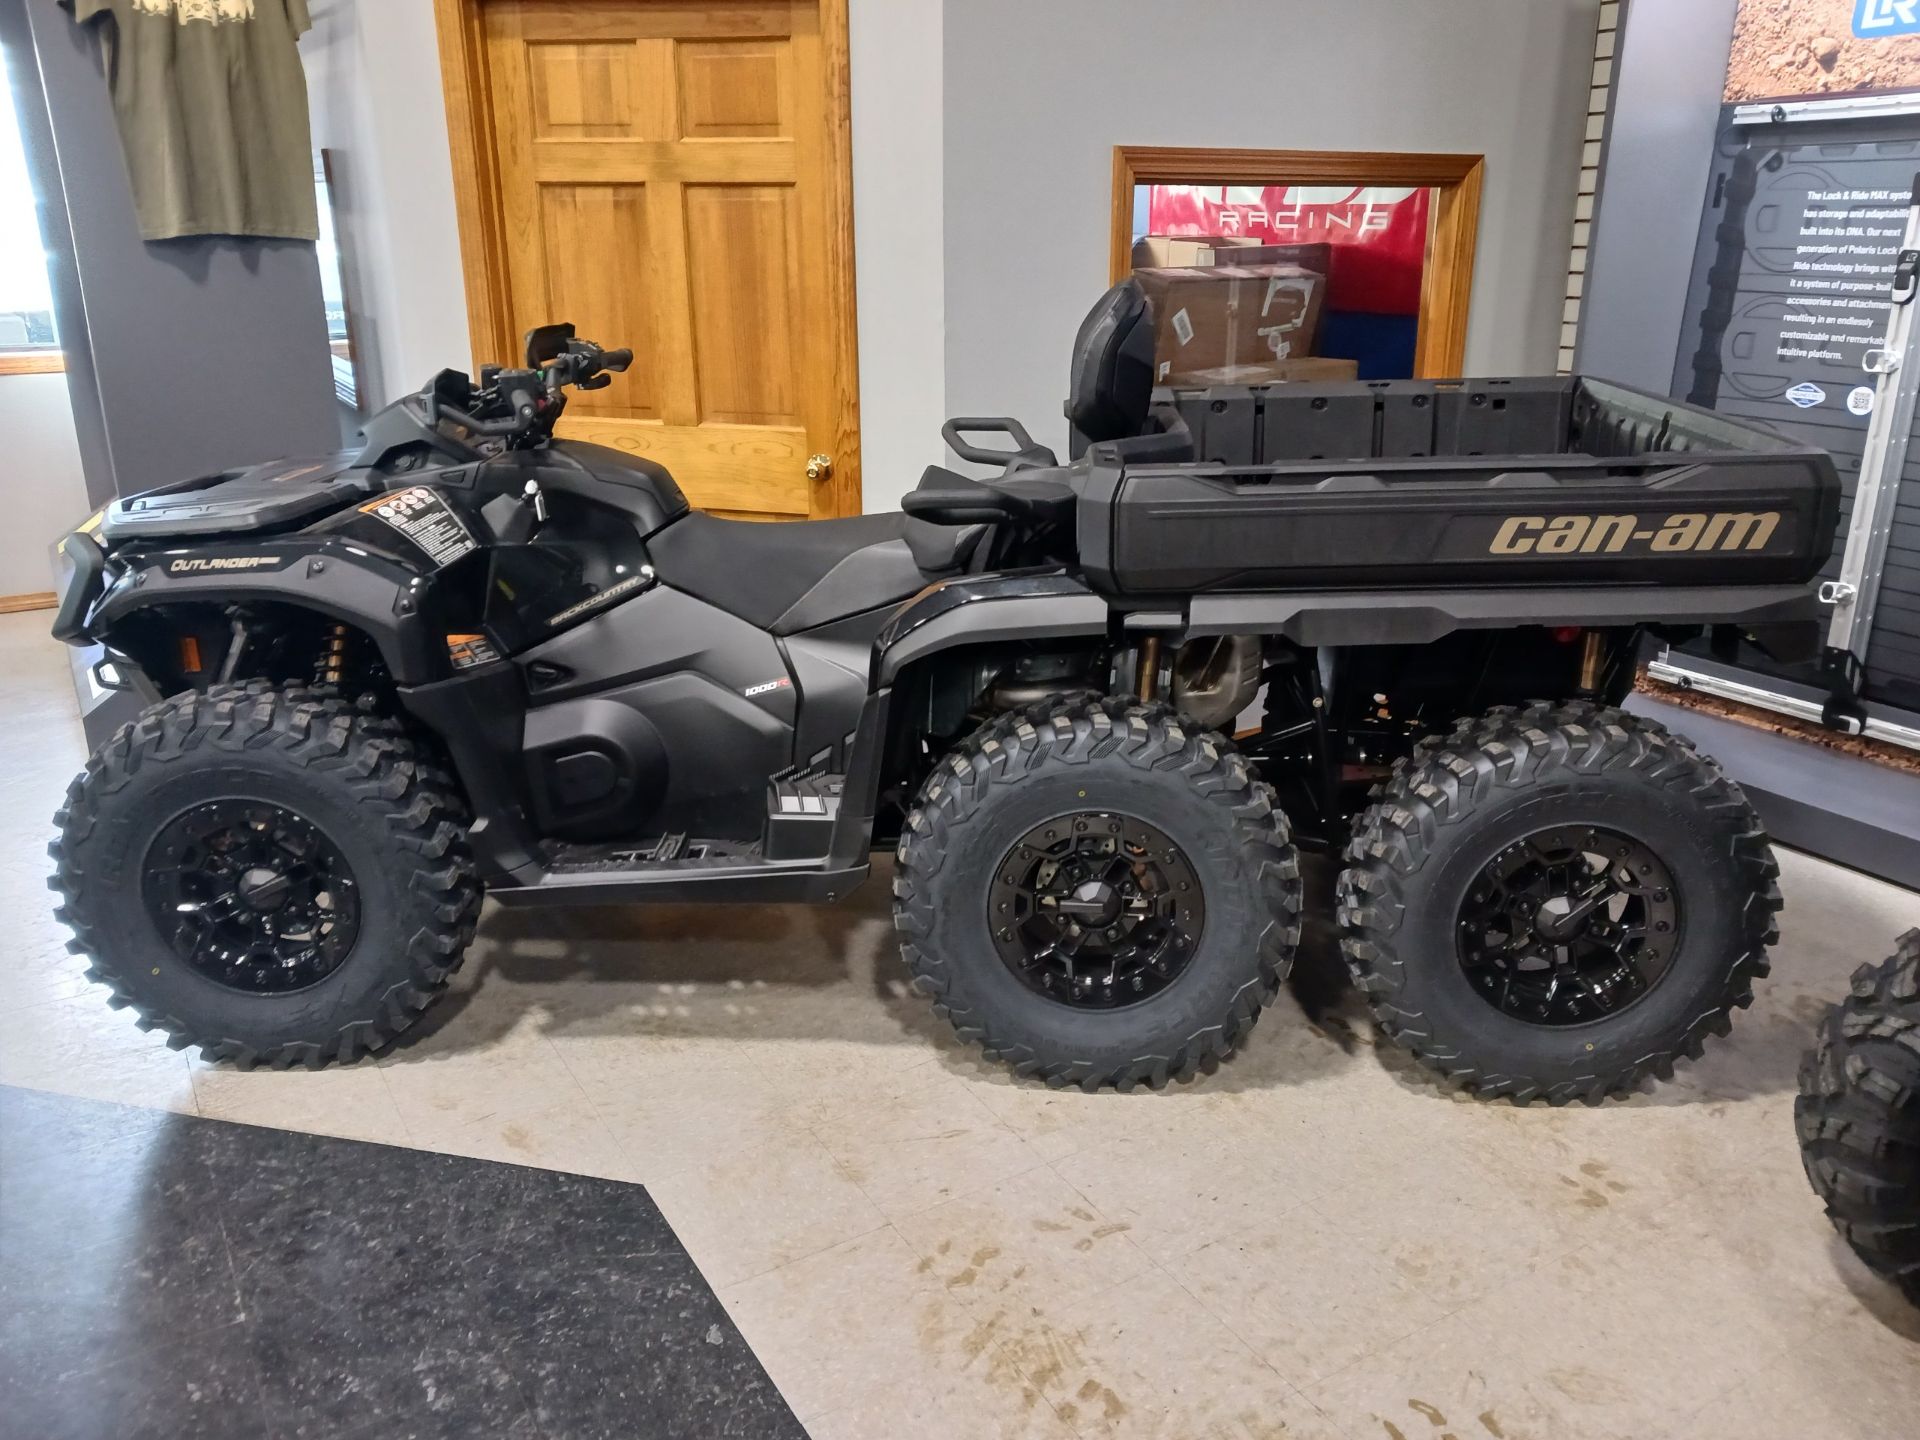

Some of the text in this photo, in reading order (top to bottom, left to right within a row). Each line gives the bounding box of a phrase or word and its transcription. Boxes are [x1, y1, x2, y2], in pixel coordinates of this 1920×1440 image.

[1807, 191, 1822, 200] The
[1823, 191, 1841, 201] Lock
[1851, 191, 1870, 200] Ride
[1870, 190, 1890, 200] MAX
[1889, 191, 1912, 202] syste
[1219, 211, 1389, 230] RACING
[1803, 209, 1910, 220] has storage and adaptabilit
[1800, 227, 1902, 237] built into its DNA. Our next
[1796, 245, 1838, 255] generation
[1838, 245, 1847, 254] of
[1848, 245, 1876, 254] Polaris
[1877, 246, 1898, 254] Lock
[1793, 261, 1811, 270] Ride
[1811, 262, 1854, 274] technology
[1854, 263, 1880, 275] brings
[1803, 280, 1831, 290] system
[1831, 280, 1841, 289] of
[1786, 297, 1891, 309] accessories and attachmen
[1783, 313, 1874, 328] resulting in an endlessly
[1780, 331, 1886, 345] customizable and remarkab
[1776, 346, 1843, 360] intuitive platform.
[1489, 511, 1781, 554] can-am
[170, 557, 260, 572] OUTLANDER
[550, 576, 639, 626] BACKCOUNTRY
[745, 678, 790, 697] 1000R
